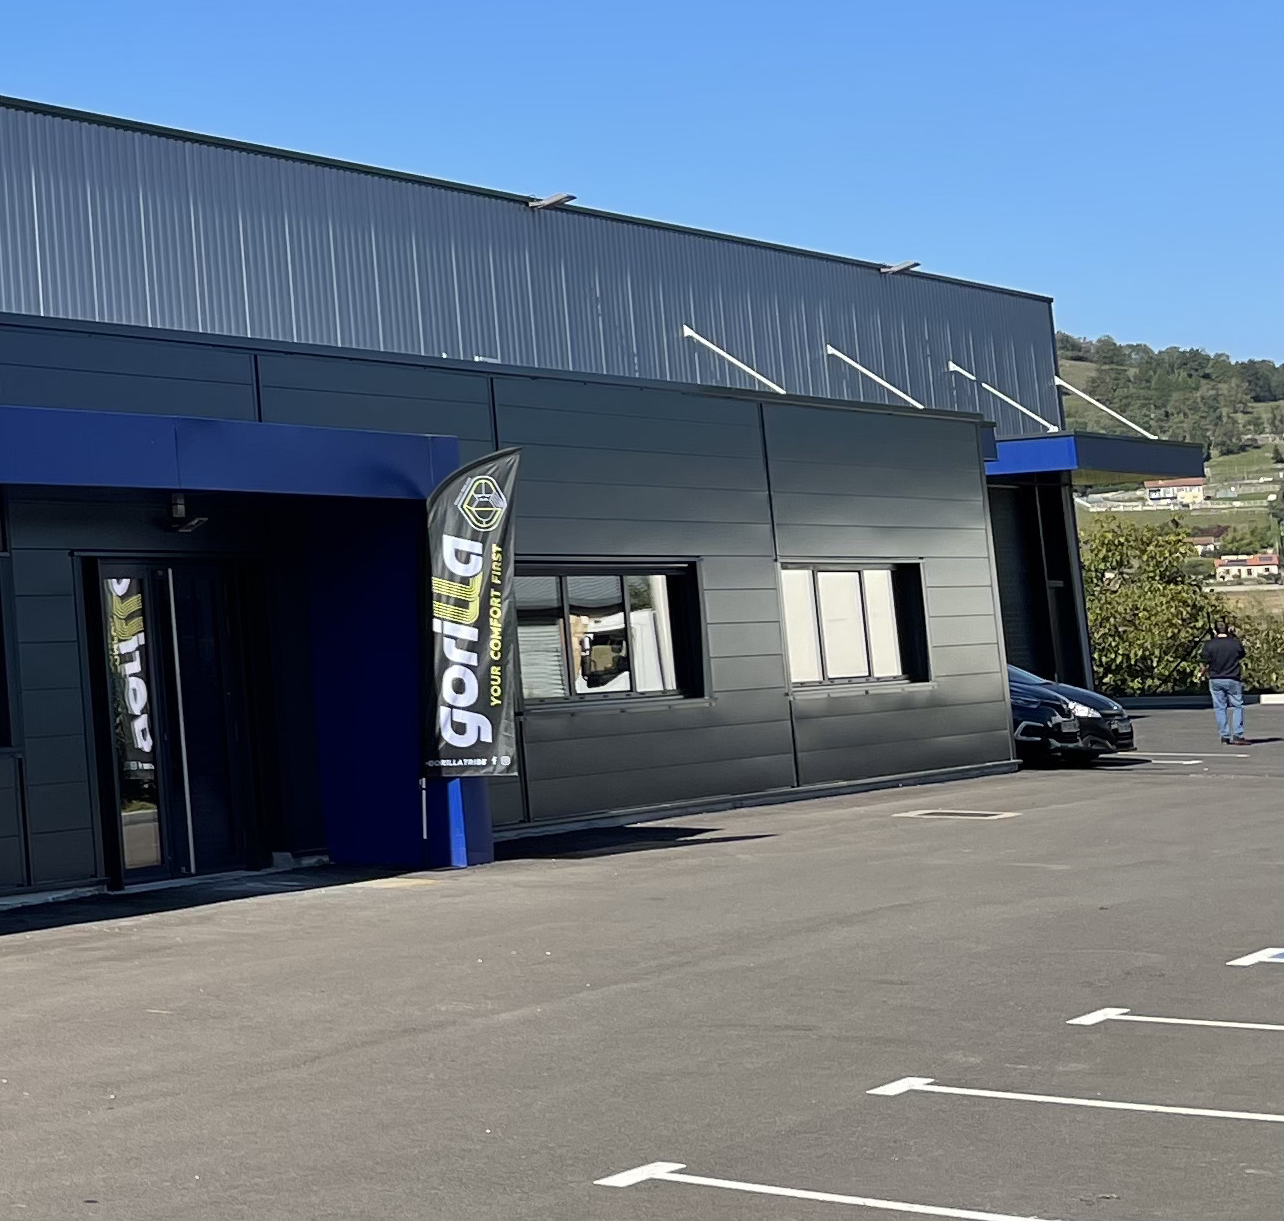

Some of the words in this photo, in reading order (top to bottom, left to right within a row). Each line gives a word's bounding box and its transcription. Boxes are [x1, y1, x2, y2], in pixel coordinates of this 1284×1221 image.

[491, 543, 503, 585] FIRST
[489, 588, 502, 661] COMFORT
[490, 666, 502, 707] YOUR
